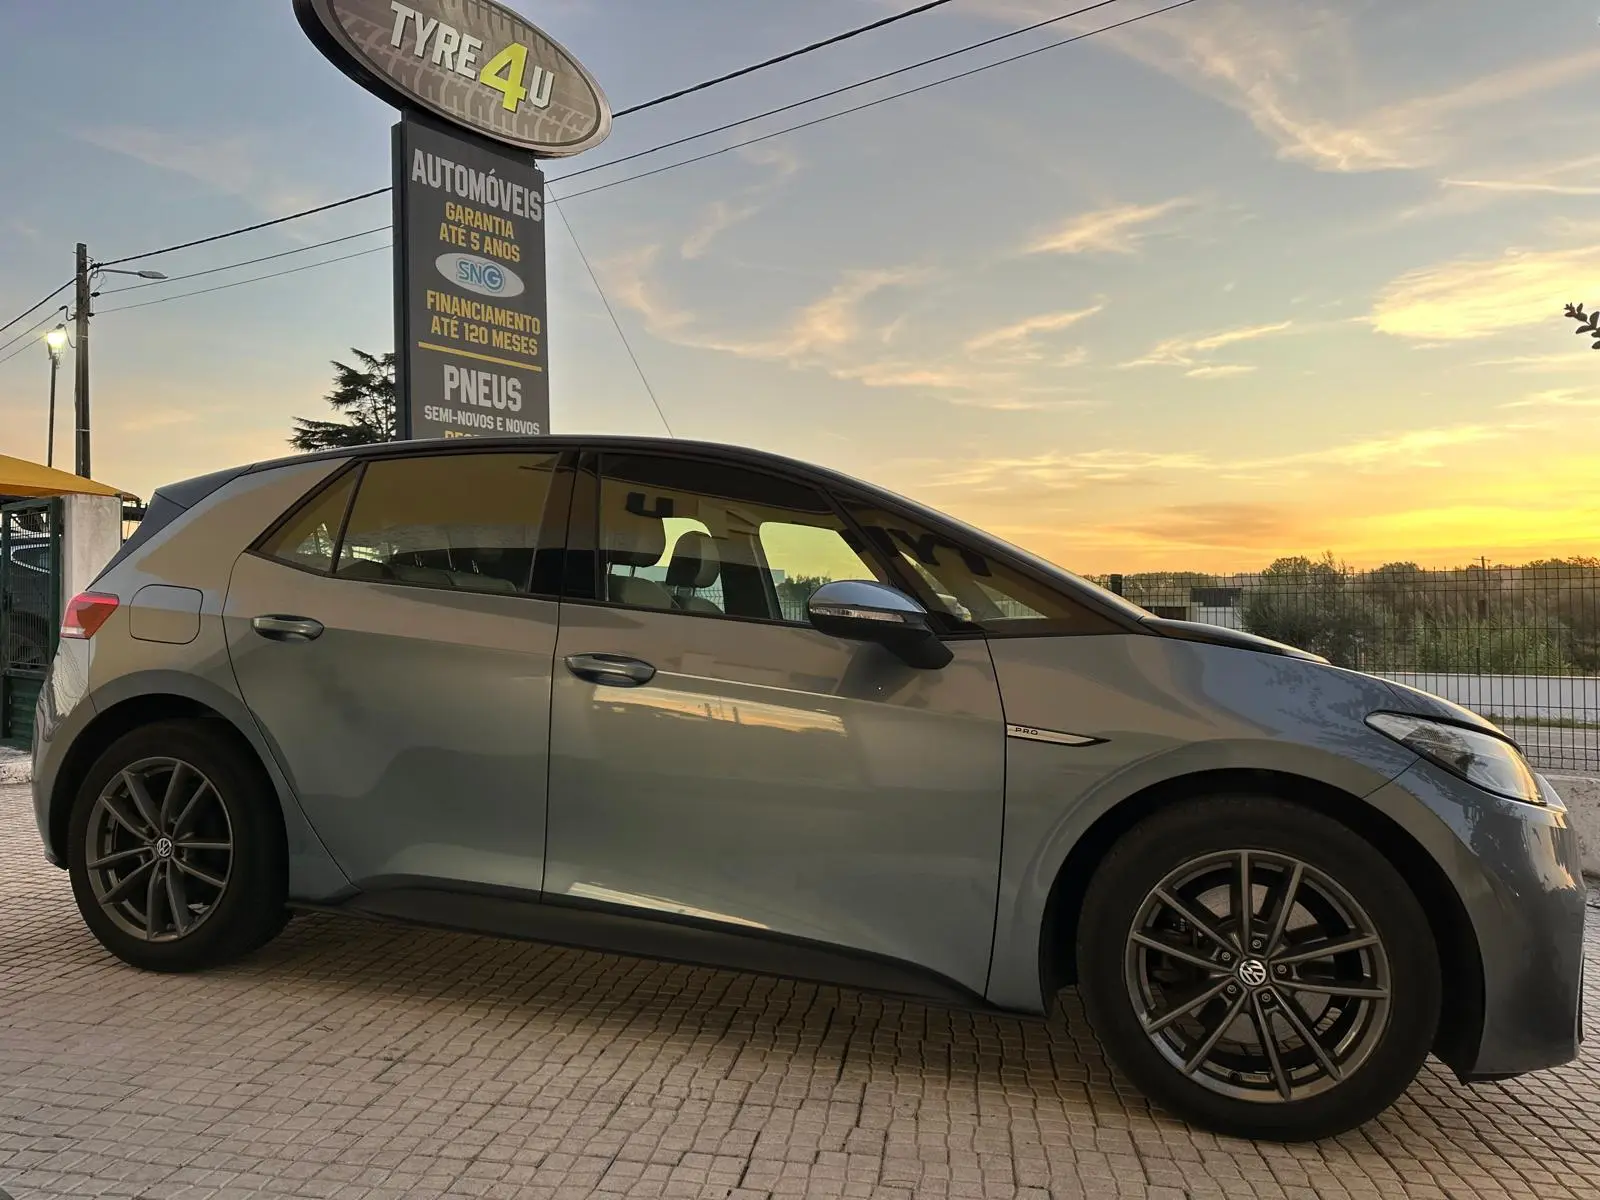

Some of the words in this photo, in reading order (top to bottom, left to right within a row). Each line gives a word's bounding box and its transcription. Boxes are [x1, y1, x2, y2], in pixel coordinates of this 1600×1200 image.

[411, 148, 543, 222] AUTOMÓVEIS
[445, 202, 515, 239] GARANTIA
[439, 222, 467, 248] ATÉ
[471, 232, 480, 252] 5
[483, 238, 521, 263] ANOS
[426, 289, 541, 335] FINANCIAMENTO
[431, 315, 460, 340] ATÉ
[463, 322, 489, 345] 120
[492, 331, 538, 356] MESES
[443, 365, 522, 412] PNEUS
[424, 404, 494, 430] SEMI-NOVOS
[496, 416, 504, 432] E
[505, 418, 540, 436] NOVOS
[1015, 727, 1039, 736] PRO
